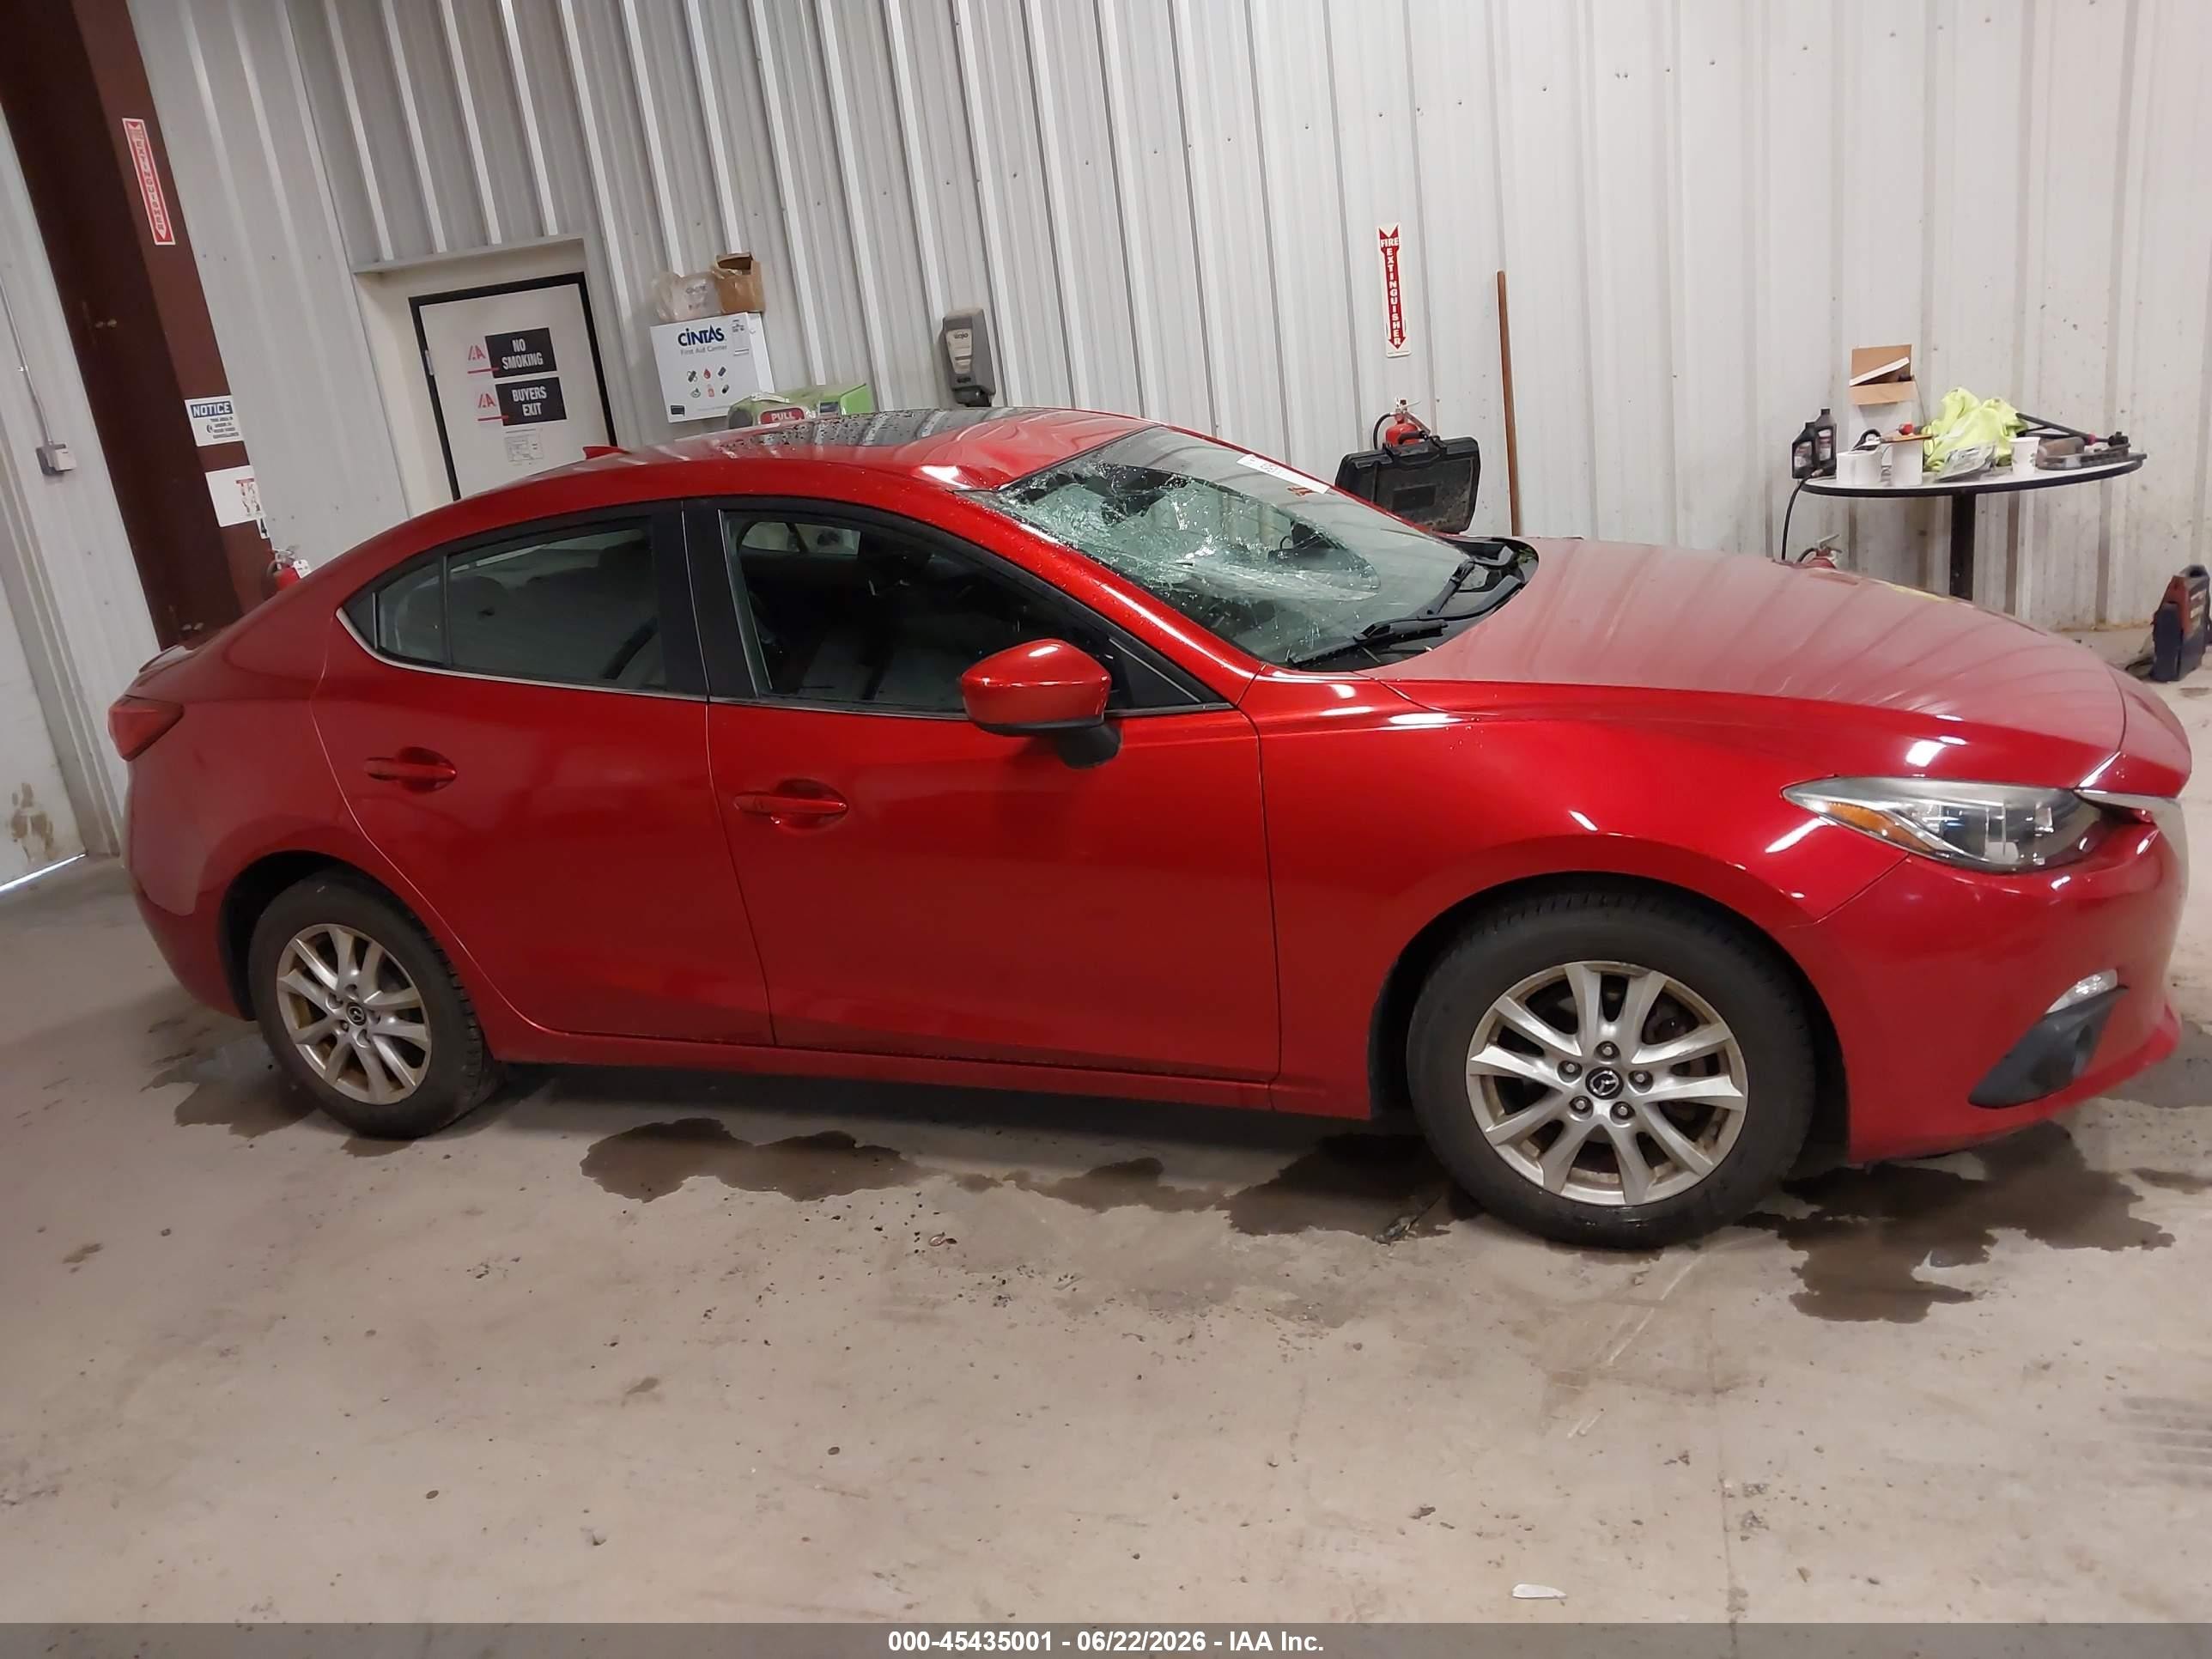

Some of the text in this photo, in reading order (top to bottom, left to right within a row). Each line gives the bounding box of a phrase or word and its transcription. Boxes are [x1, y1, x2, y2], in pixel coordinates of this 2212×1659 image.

[136, 140, 165, 230] EXTINGUISHER
[1380, 237, 1400, 247] FIRE
[1386, 247, 1401, 345] EXTINGUISHER
[512, 338, 526, 352] NO
[501, 352, 544, 370] SMOKING
[511, 386, 547, 402] BUYERS
[192, 403, 231, 416] NOTICE
[522, 403, 542, 416] EXIT
[770, 411, 795, 421] PULL
